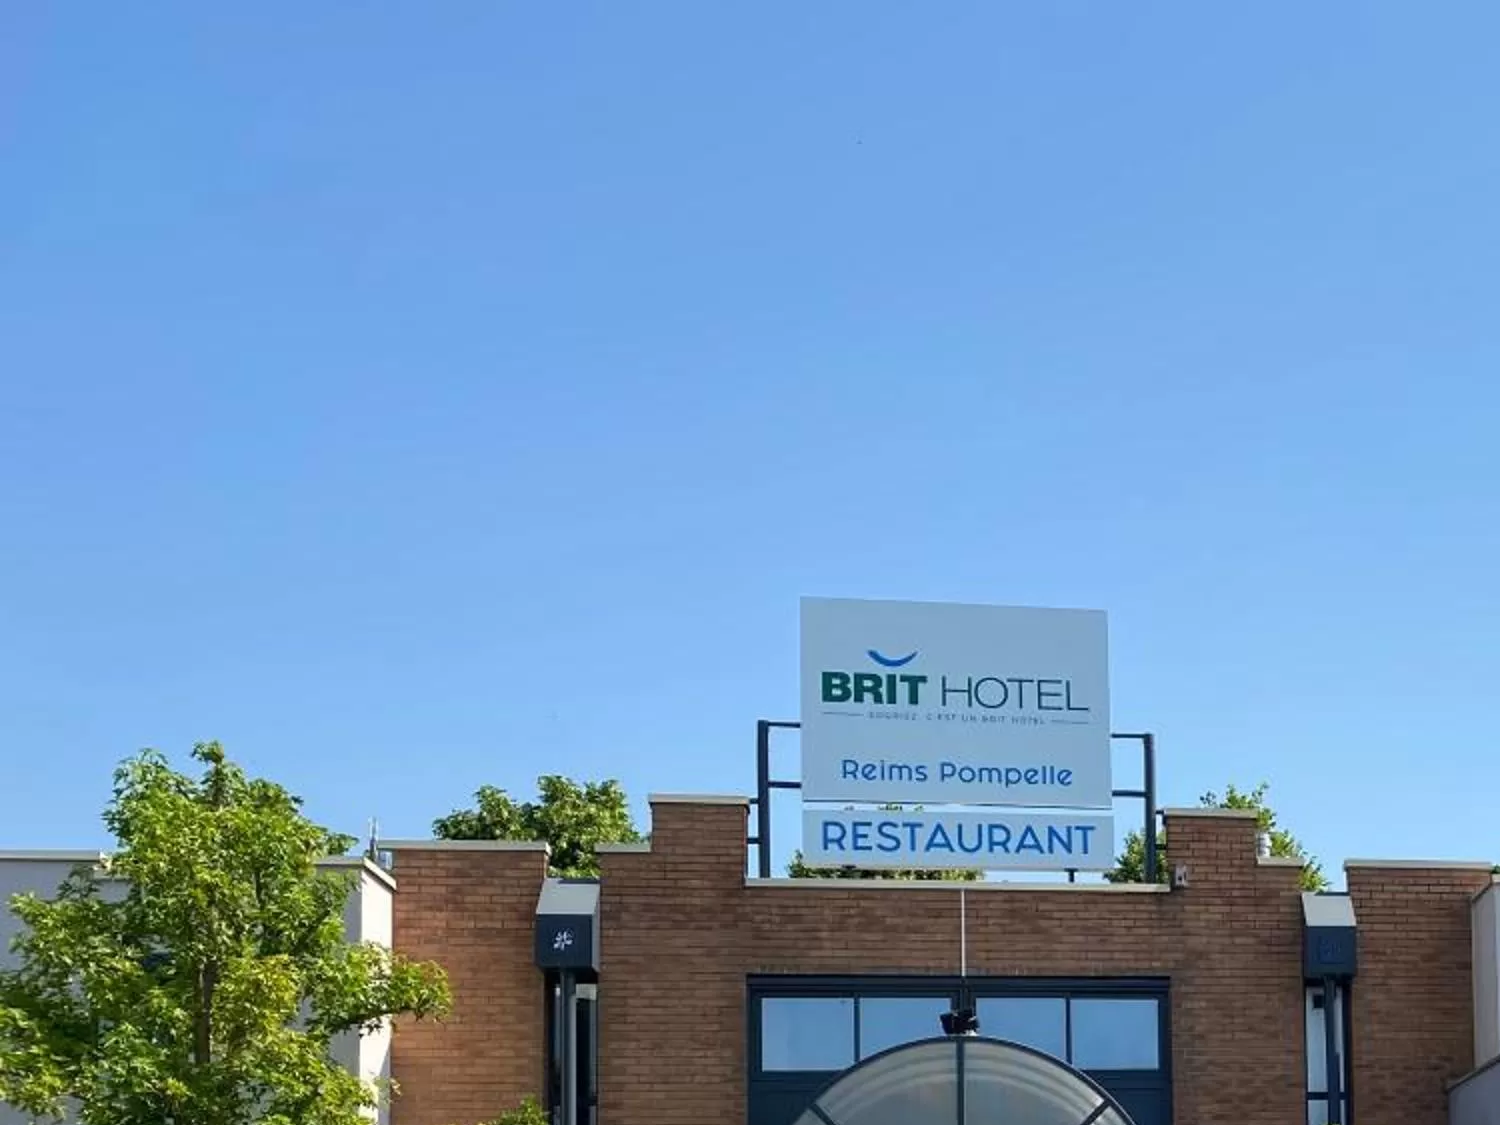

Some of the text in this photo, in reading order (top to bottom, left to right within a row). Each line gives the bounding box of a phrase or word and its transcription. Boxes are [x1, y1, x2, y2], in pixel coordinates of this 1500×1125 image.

[821, 671, 1089, 712] BRIT HOTEL
[841, 759, 1073, 788] Reims Pompelle
[822, 821, 1096, 855] RESTAURANT
